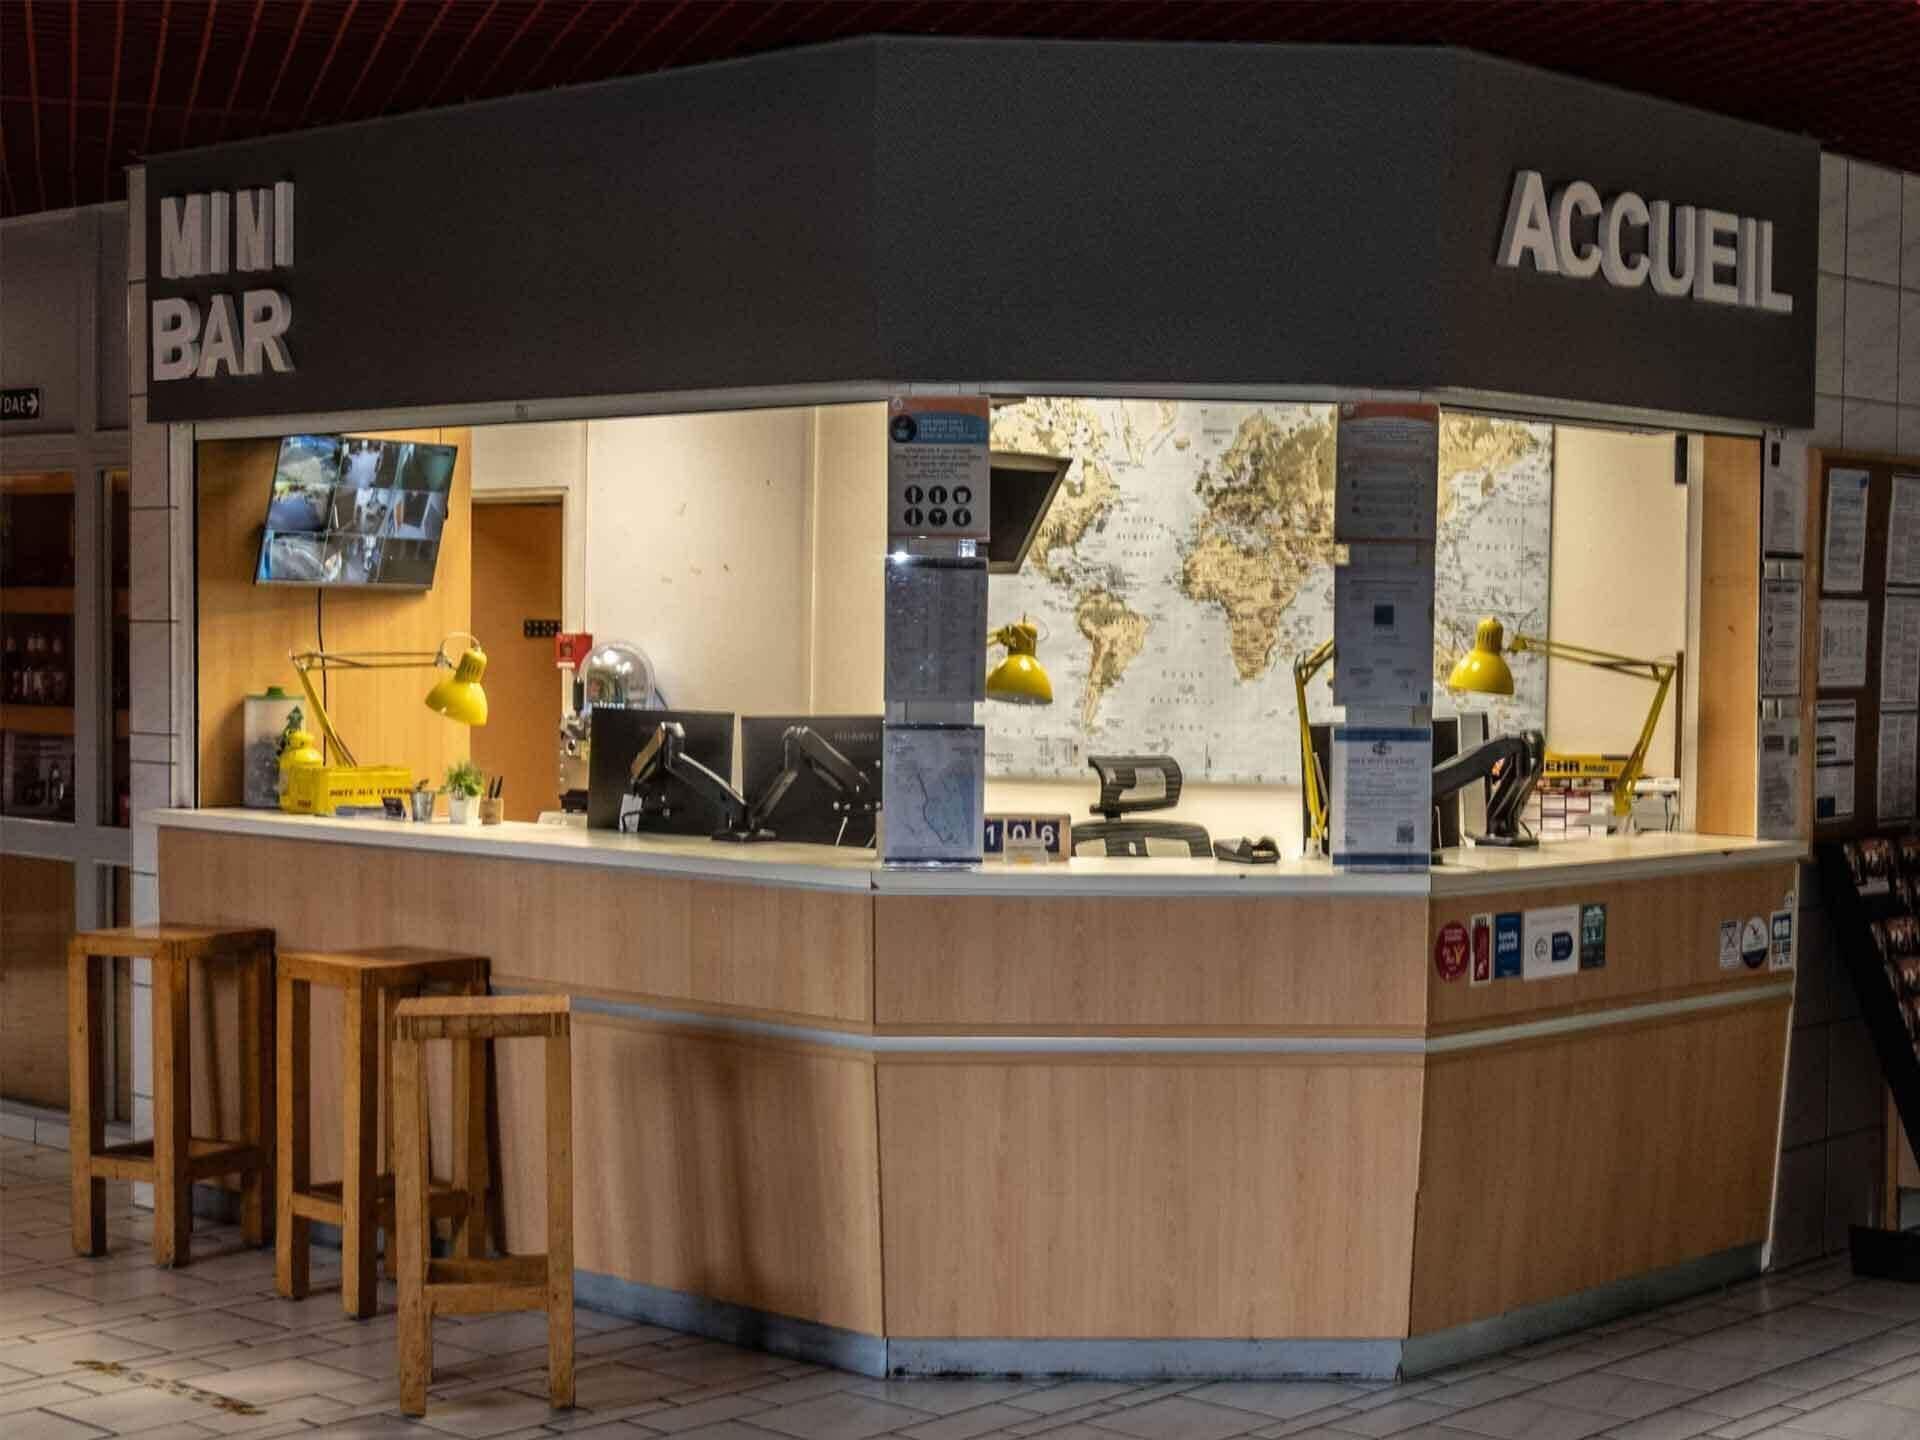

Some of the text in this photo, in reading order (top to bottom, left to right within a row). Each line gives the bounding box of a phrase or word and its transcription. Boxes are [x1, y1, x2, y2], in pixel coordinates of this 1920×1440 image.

[160, 181, 295, 279] MINI
[1496, 169, 1793, 312] ACCUEIL
[153, 289, 296, 381] BAR
